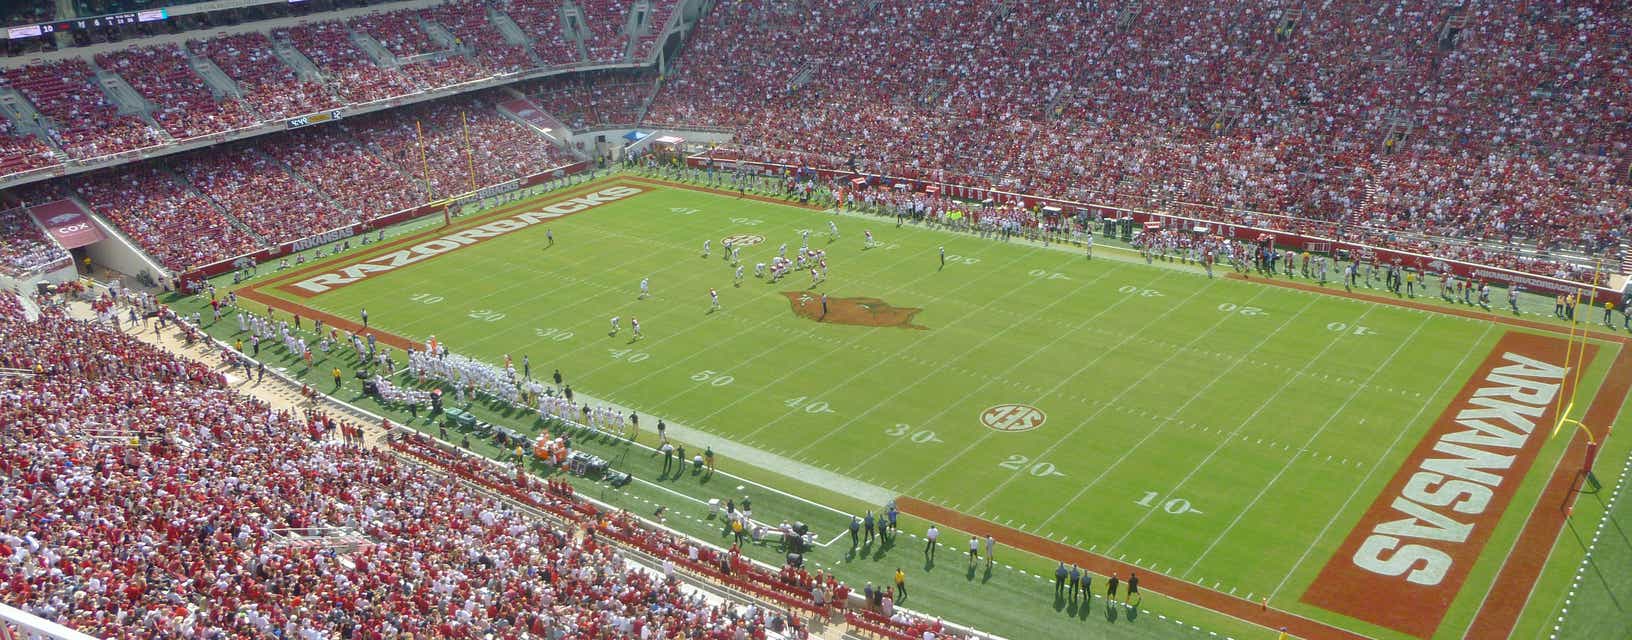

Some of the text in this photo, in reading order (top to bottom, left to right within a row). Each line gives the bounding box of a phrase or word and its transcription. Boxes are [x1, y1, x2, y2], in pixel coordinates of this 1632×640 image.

[59, 223, 89, 234] COX
[293, 186, 642, 293] RAZORBACKS
[293, 227, 353, 253] ARKANSAS
[467, 310, 506, 322] 20
[1217, 302, 1261, 316] 20
[535, 327, 575, 342] 30
[1327, 321, 1366, 336] 10
[608, 348, 649, 363] 40
[690, 370, 735, 386] 50
[783, 395, 827, 414] 40
[984, 405, 1041, 430] SEC
[885, 422, 933, 444] 30
[999, 454, 1055, 477] 20
[1352, 352, 1571, 587] ARKANSAS
[1134, 491, 1191, 515] 10
